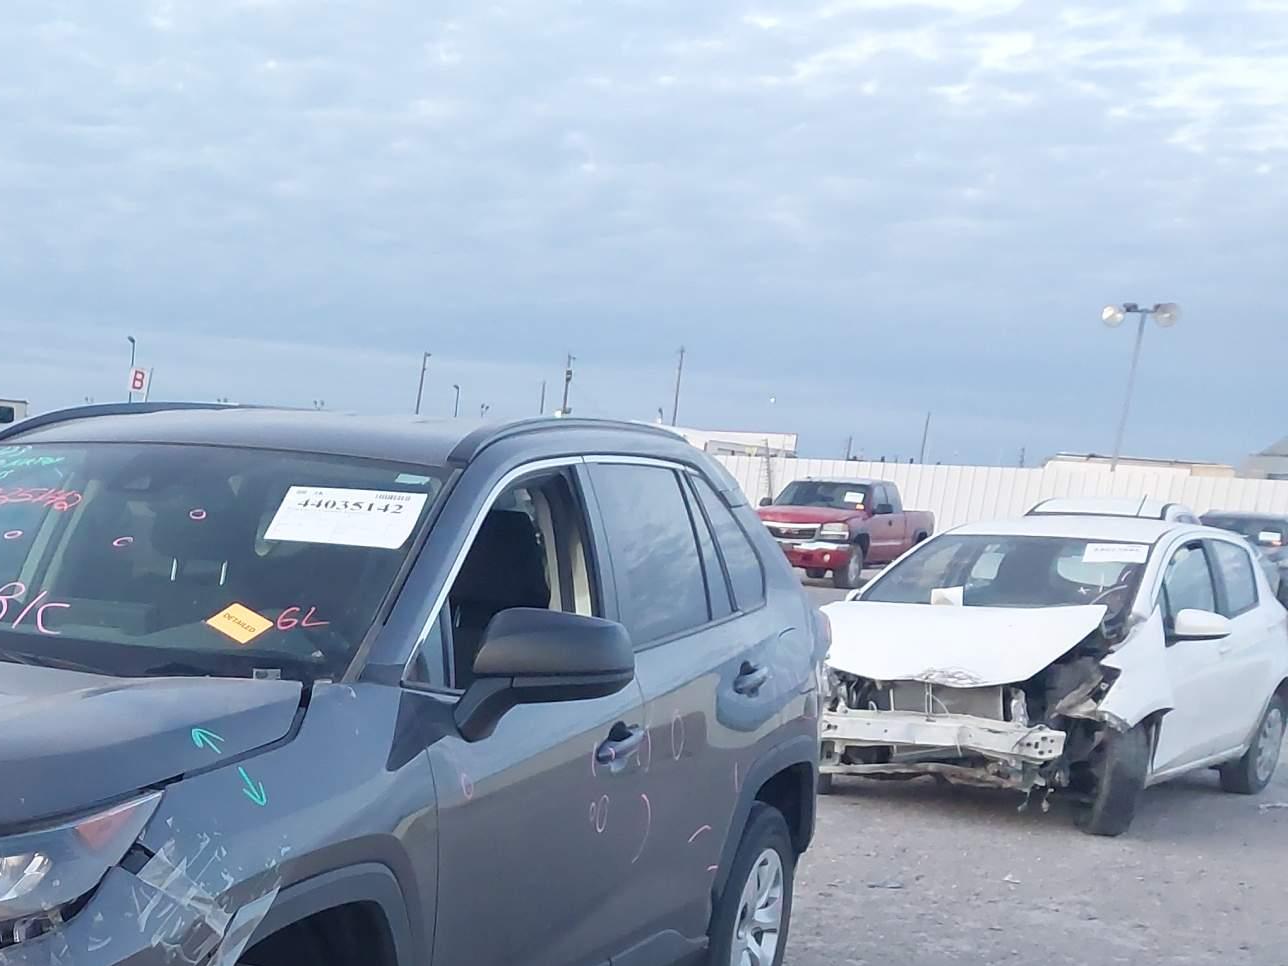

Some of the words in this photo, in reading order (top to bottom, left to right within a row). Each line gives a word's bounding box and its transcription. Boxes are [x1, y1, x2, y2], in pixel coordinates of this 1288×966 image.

[131, 369, 145, 390] B
[297, 498, 404, 514] 44035142
[222, 612, 257, 634] DETAILED
